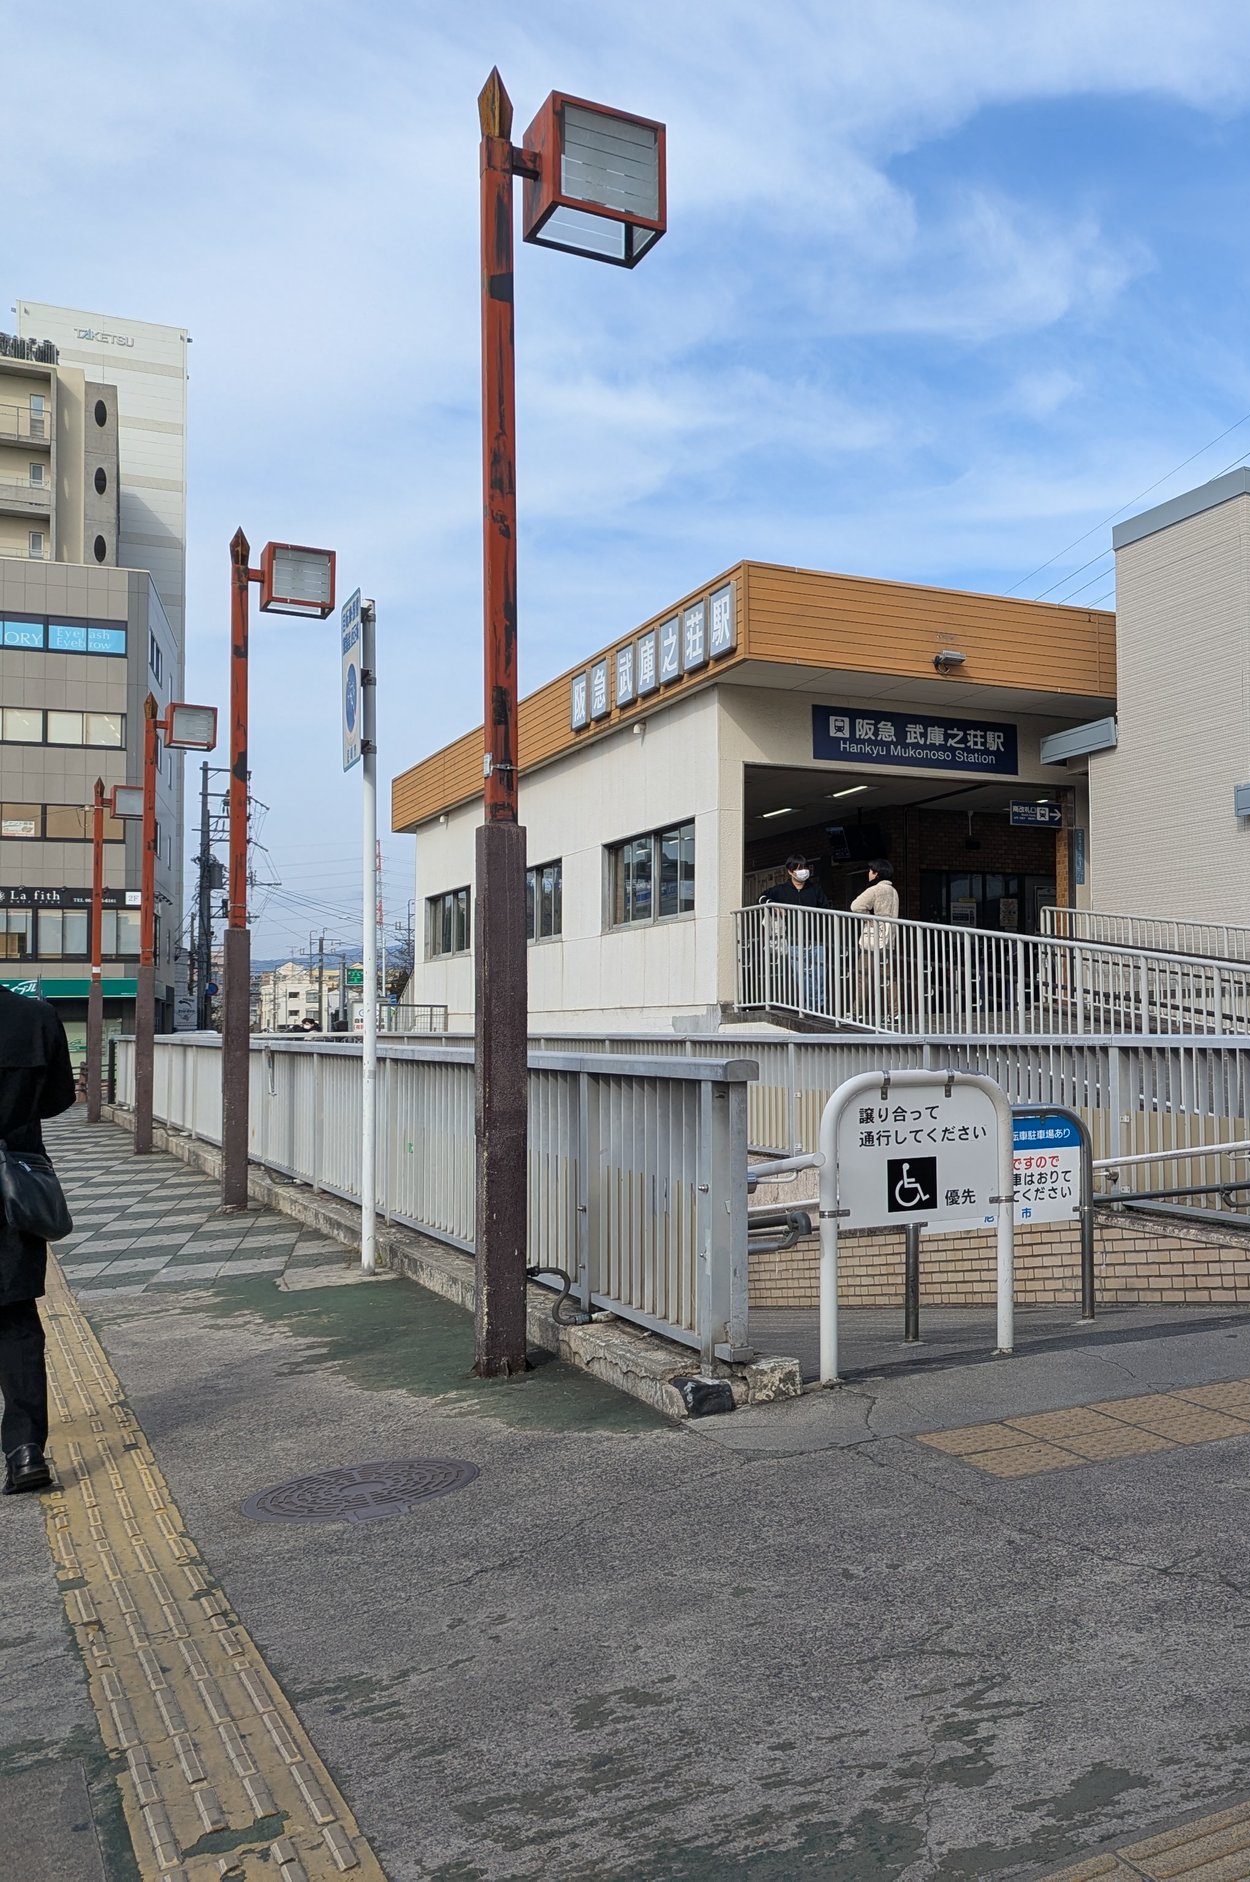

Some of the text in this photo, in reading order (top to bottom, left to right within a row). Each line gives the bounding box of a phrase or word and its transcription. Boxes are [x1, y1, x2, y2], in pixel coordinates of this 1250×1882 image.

[574, 594, 730, 722] 阪急 武庫之荘駅
[855, 718, 1005, 752] 阪急 武庫之荘駅
[840, 740, 996, 764] Hankyu Mukonoso Station
[34, 890, 60, 900] fith
[859, 1105, 940, 1125] 譲り合って
[859, 1125, 987, 1147] 通行してください
[944, 1187, 976, 1206] 優先
